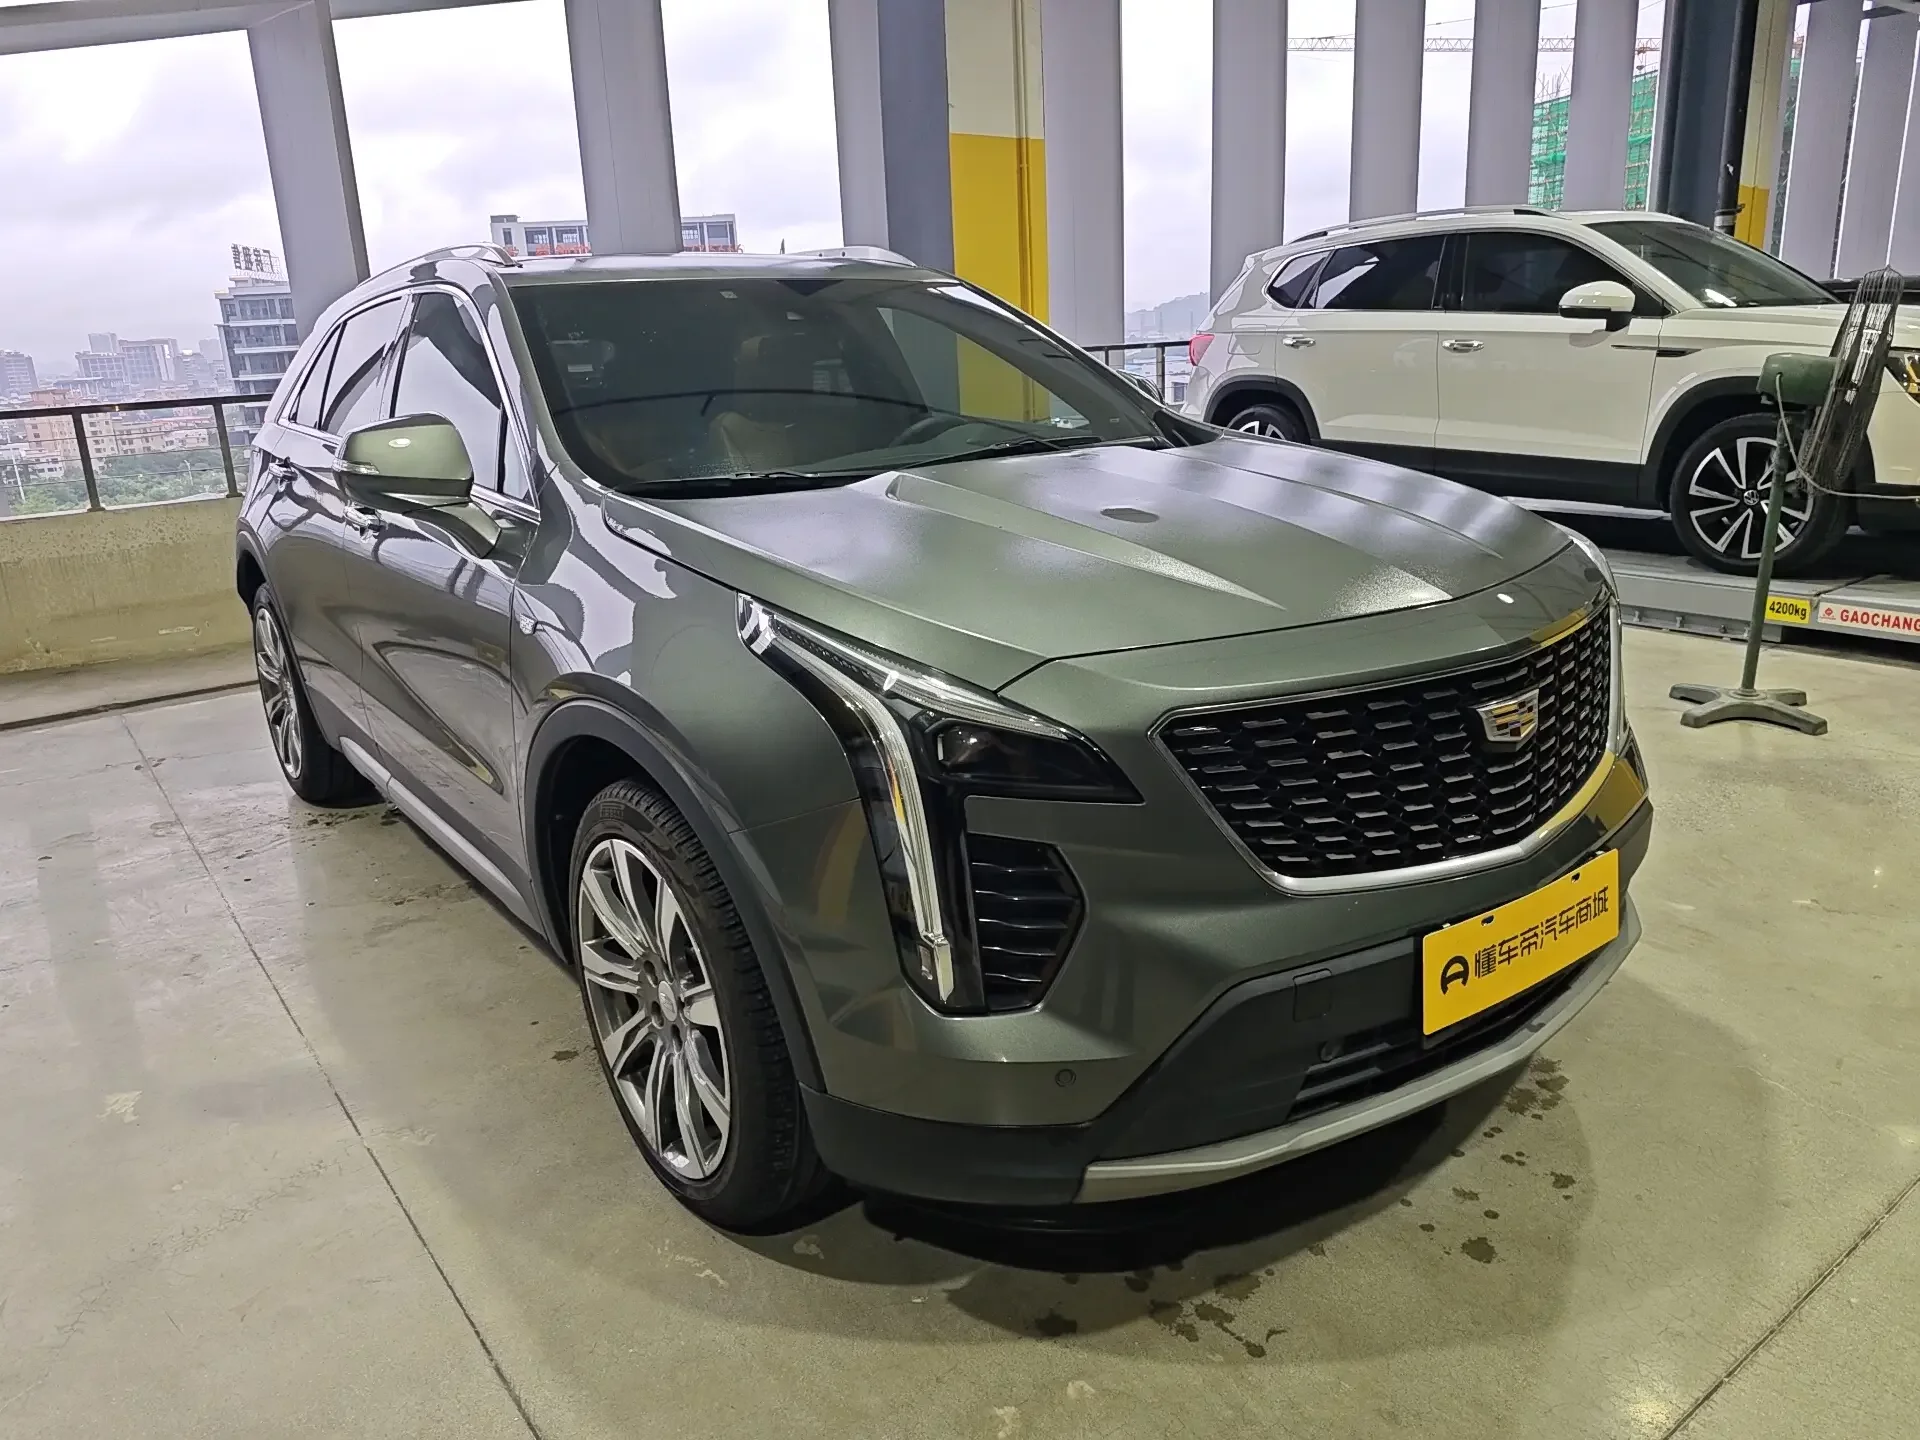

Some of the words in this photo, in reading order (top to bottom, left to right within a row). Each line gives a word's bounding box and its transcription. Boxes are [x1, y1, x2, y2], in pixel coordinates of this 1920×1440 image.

[1769, 600, 1807, 620] 4200kg
[1474, 886, 1608, 979] 懂车帝汽车商城
